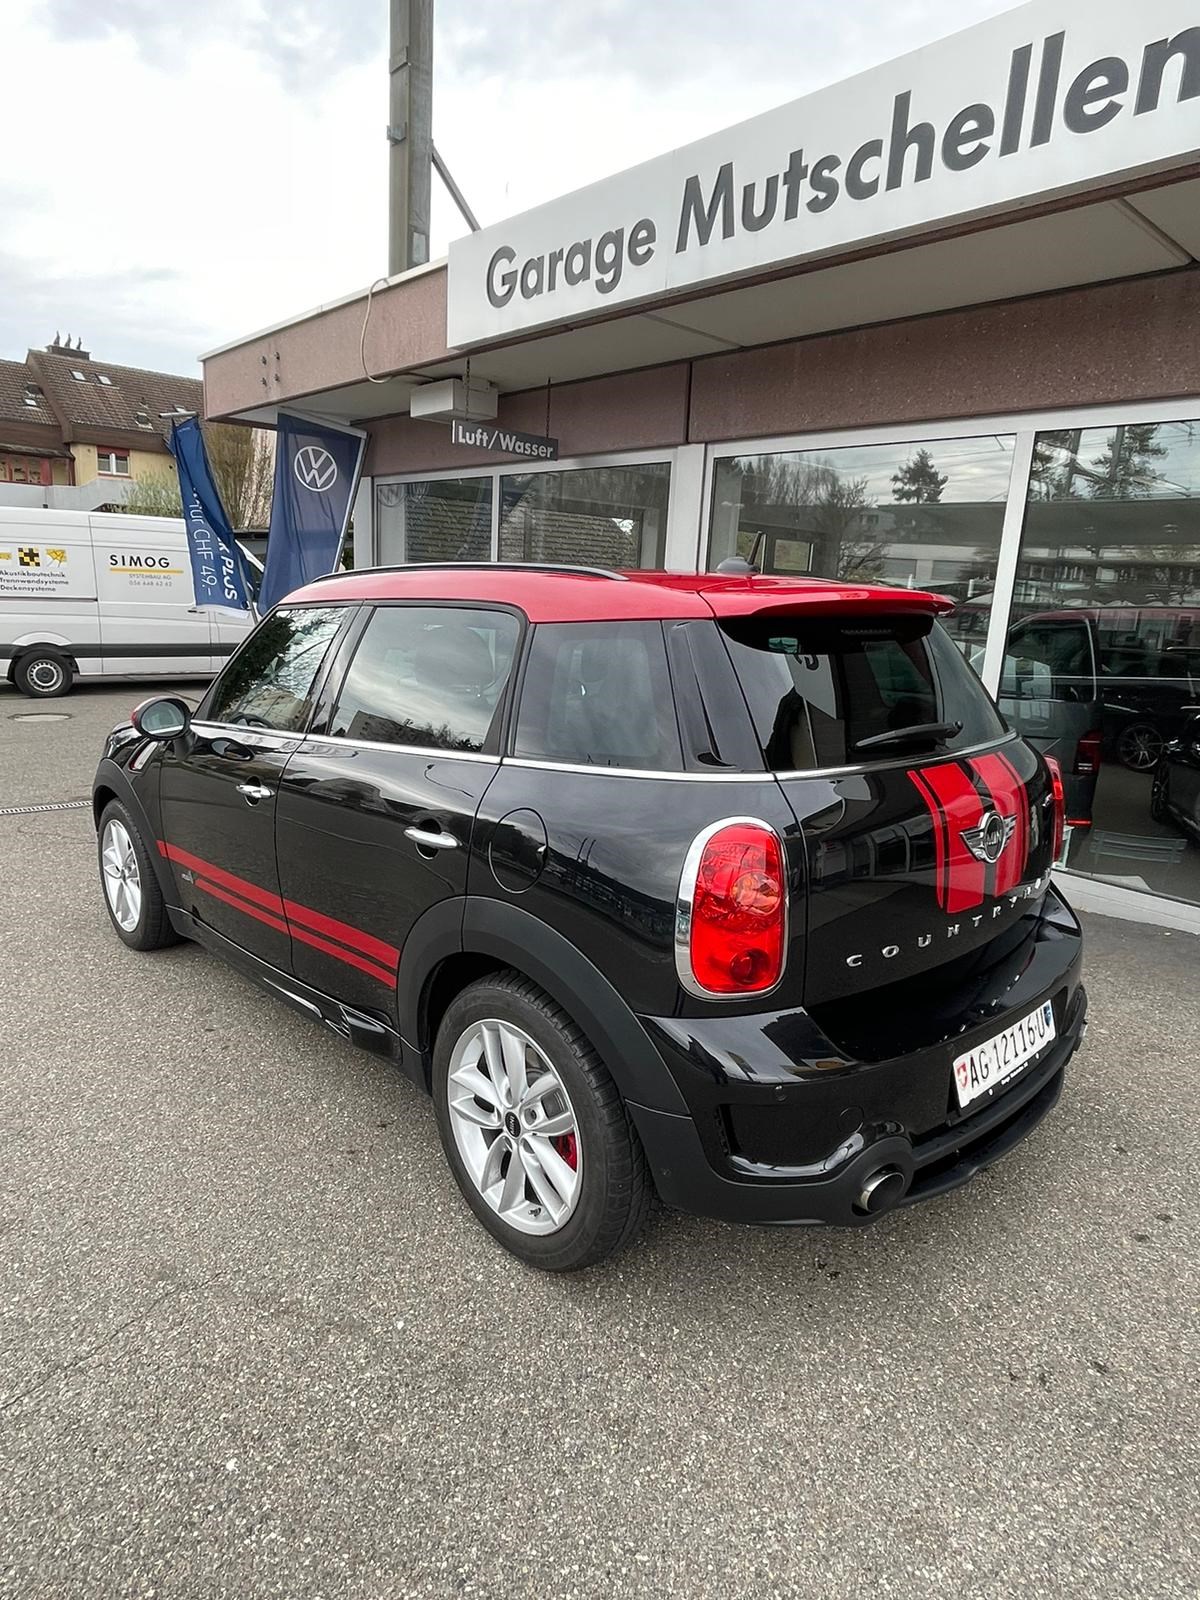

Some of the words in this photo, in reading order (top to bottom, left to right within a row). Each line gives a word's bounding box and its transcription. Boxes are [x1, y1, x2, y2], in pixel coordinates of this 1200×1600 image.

[486, 218, 657, 309] Garage
[675, 26, 1200, 254] Mutschellen
[458, 425, 554, 459] Luft/Wasser
[110, 554, 170, 568] SIMOG
[194, 529, 214, 560] CHF
[220, 555, 238, 600] PLUS
